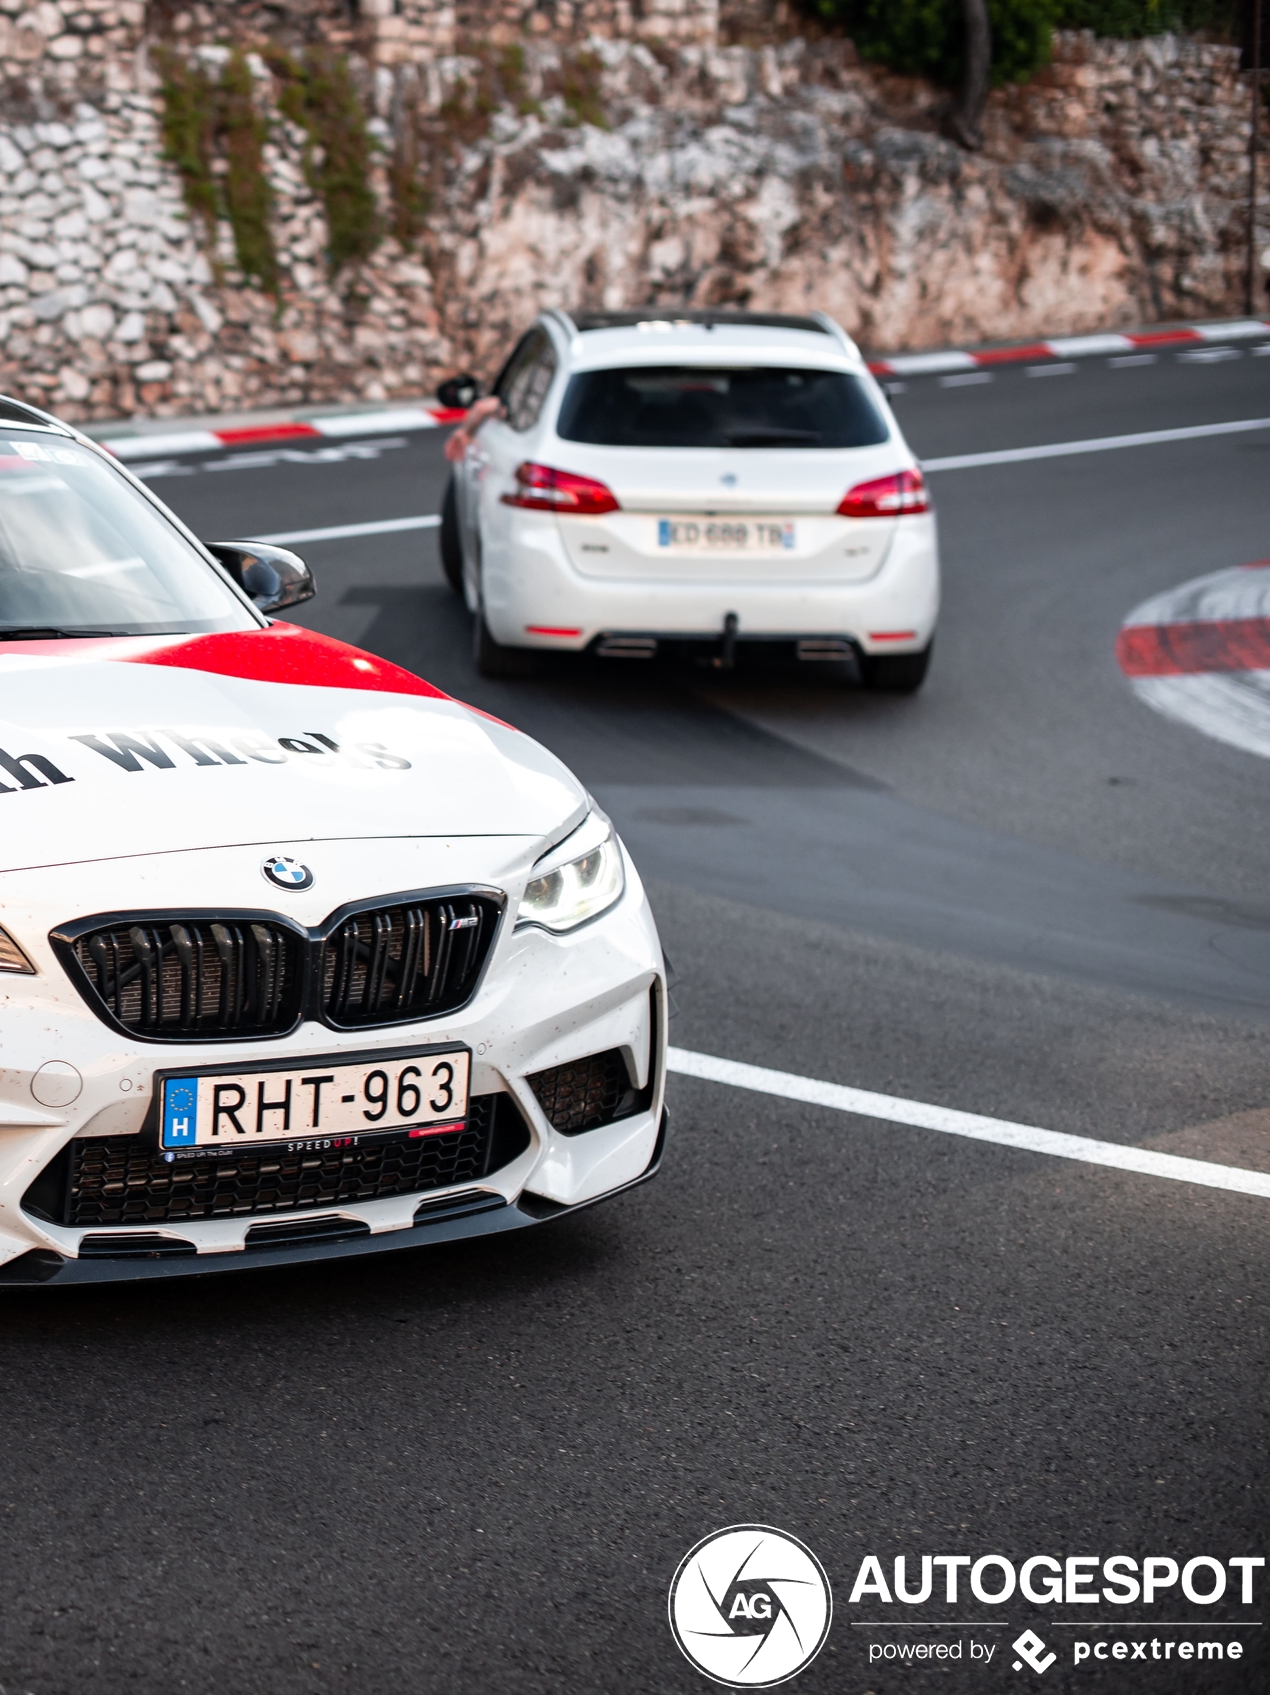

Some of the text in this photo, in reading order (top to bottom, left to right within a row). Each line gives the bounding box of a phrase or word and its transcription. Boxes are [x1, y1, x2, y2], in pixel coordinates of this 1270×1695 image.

[67, 729, 412, 773] Wheels
[211, 1060, 454, 1137] RHT-963
[171, 1117, 189, 1137] H
